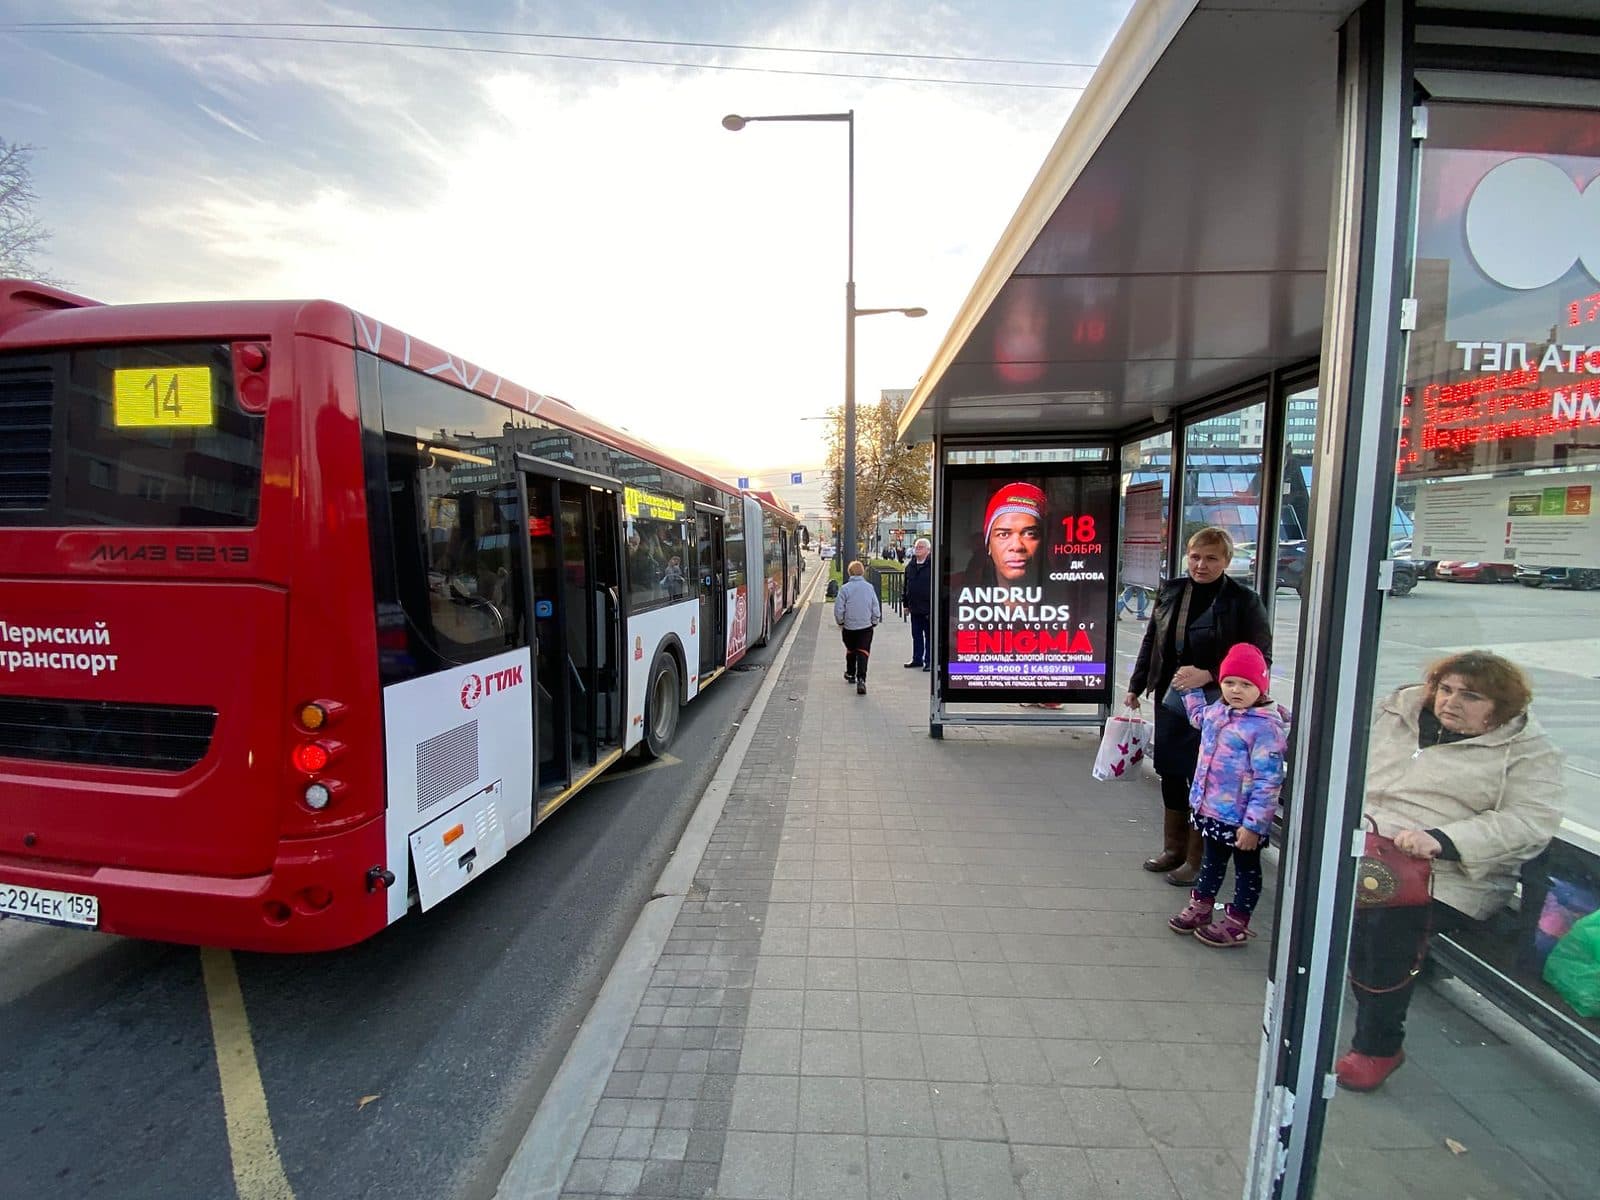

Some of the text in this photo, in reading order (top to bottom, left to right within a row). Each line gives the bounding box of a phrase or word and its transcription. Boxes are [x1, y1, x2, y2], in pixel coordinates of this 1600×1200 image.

[144, 373, 183, 418] 14
[1062, 515, 1096, 543] 18
[90, 544, 249, 562] ЛИАЗ 6213
[1054, 544, 1102, 554] НОЯБРЯ
[1070, 560, 1084, 570] ДК
[1049, 572, 1105, 581] СОЛДАТОВА
[958, 586, 1042, 604] ANDRU
[958, 605, 1070, 622] DONALDS
[1078, 622, 1095, 630] OF
[957, 630, 1094, 654] ENIGMA
[1045, 654, 1066, 662] ГОЛОС
[978, 665, 1075, 673] 235-0000 KASSY.RU
[485, 665, 523, 696] ГТЛК
[1084, 675, 1101, 687] 12+
[67, 896, 93, 915] 159
